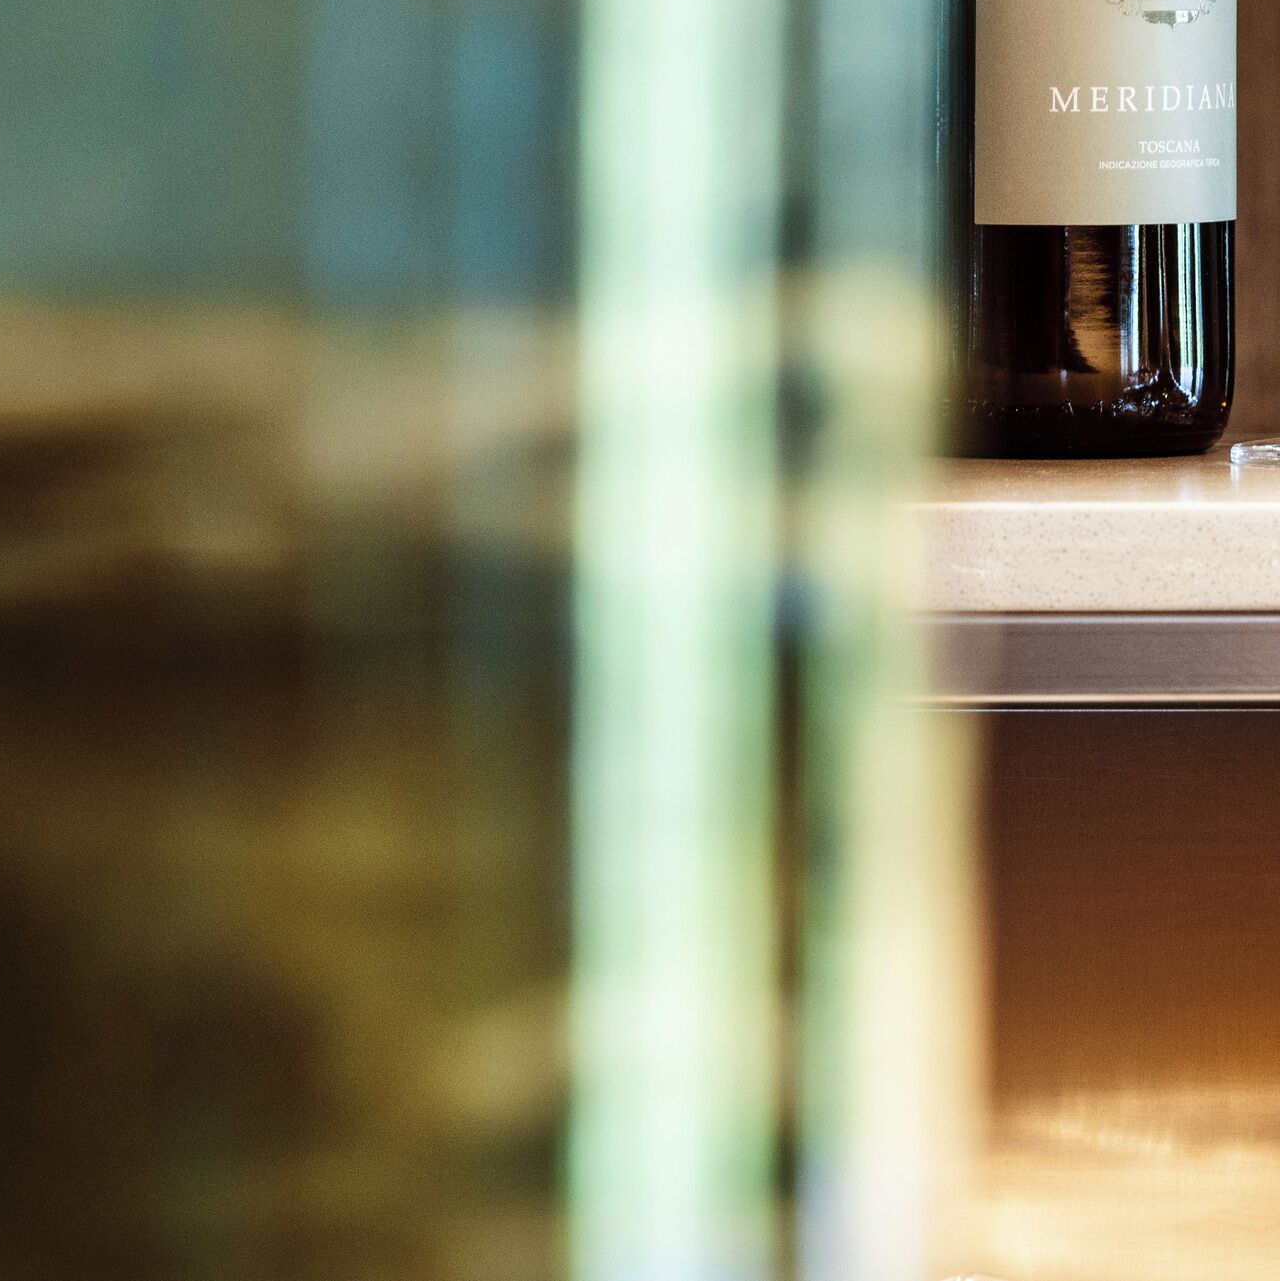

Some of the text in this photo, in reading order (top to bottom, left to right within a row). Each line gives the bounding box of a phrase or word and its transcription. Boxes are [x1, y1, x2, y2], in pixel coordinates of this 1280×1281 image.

[1049, 82, 1235, 113] MERIDIANA
[1138, 139, 1201, 154] TOSCANA
[1099, 160, 1158, 170] INDICAZIONE
[1159, 158, 1204, 169] GEOGRAFICA
